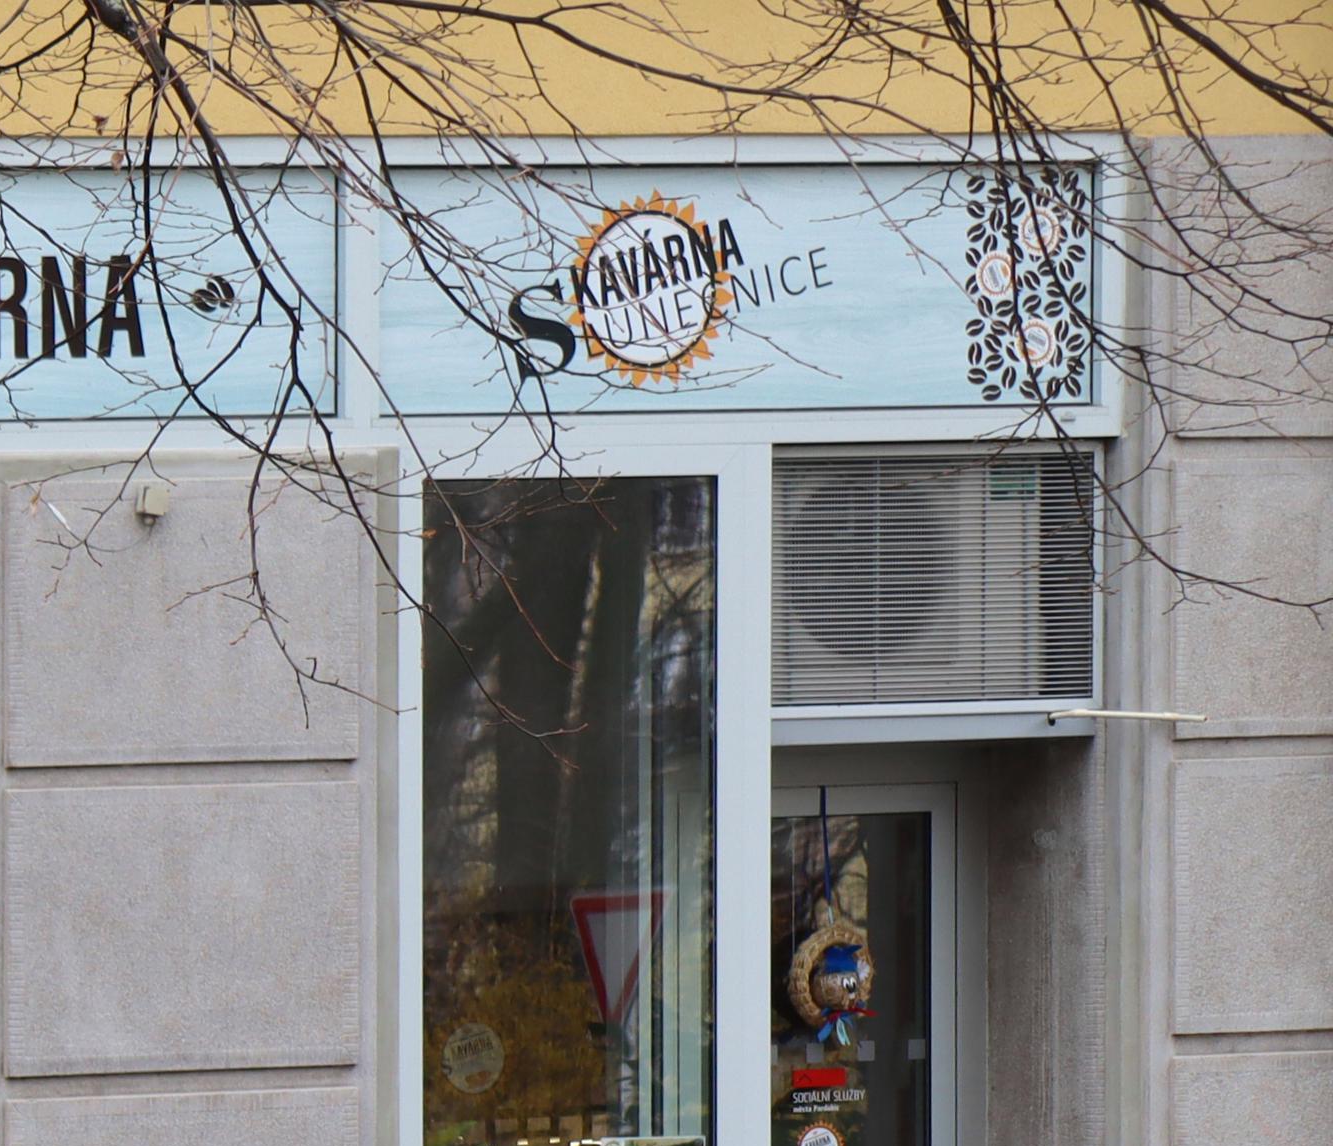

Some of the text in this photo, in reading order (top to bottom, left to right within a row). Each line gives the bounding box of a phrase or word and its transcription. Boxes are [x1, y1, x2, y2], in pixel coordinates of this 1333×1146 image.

[570, 218, 745, 309] KAVÁRNA
[793, 1088, 866, 1104] SOCIÁLNÍ SLUŽBY
